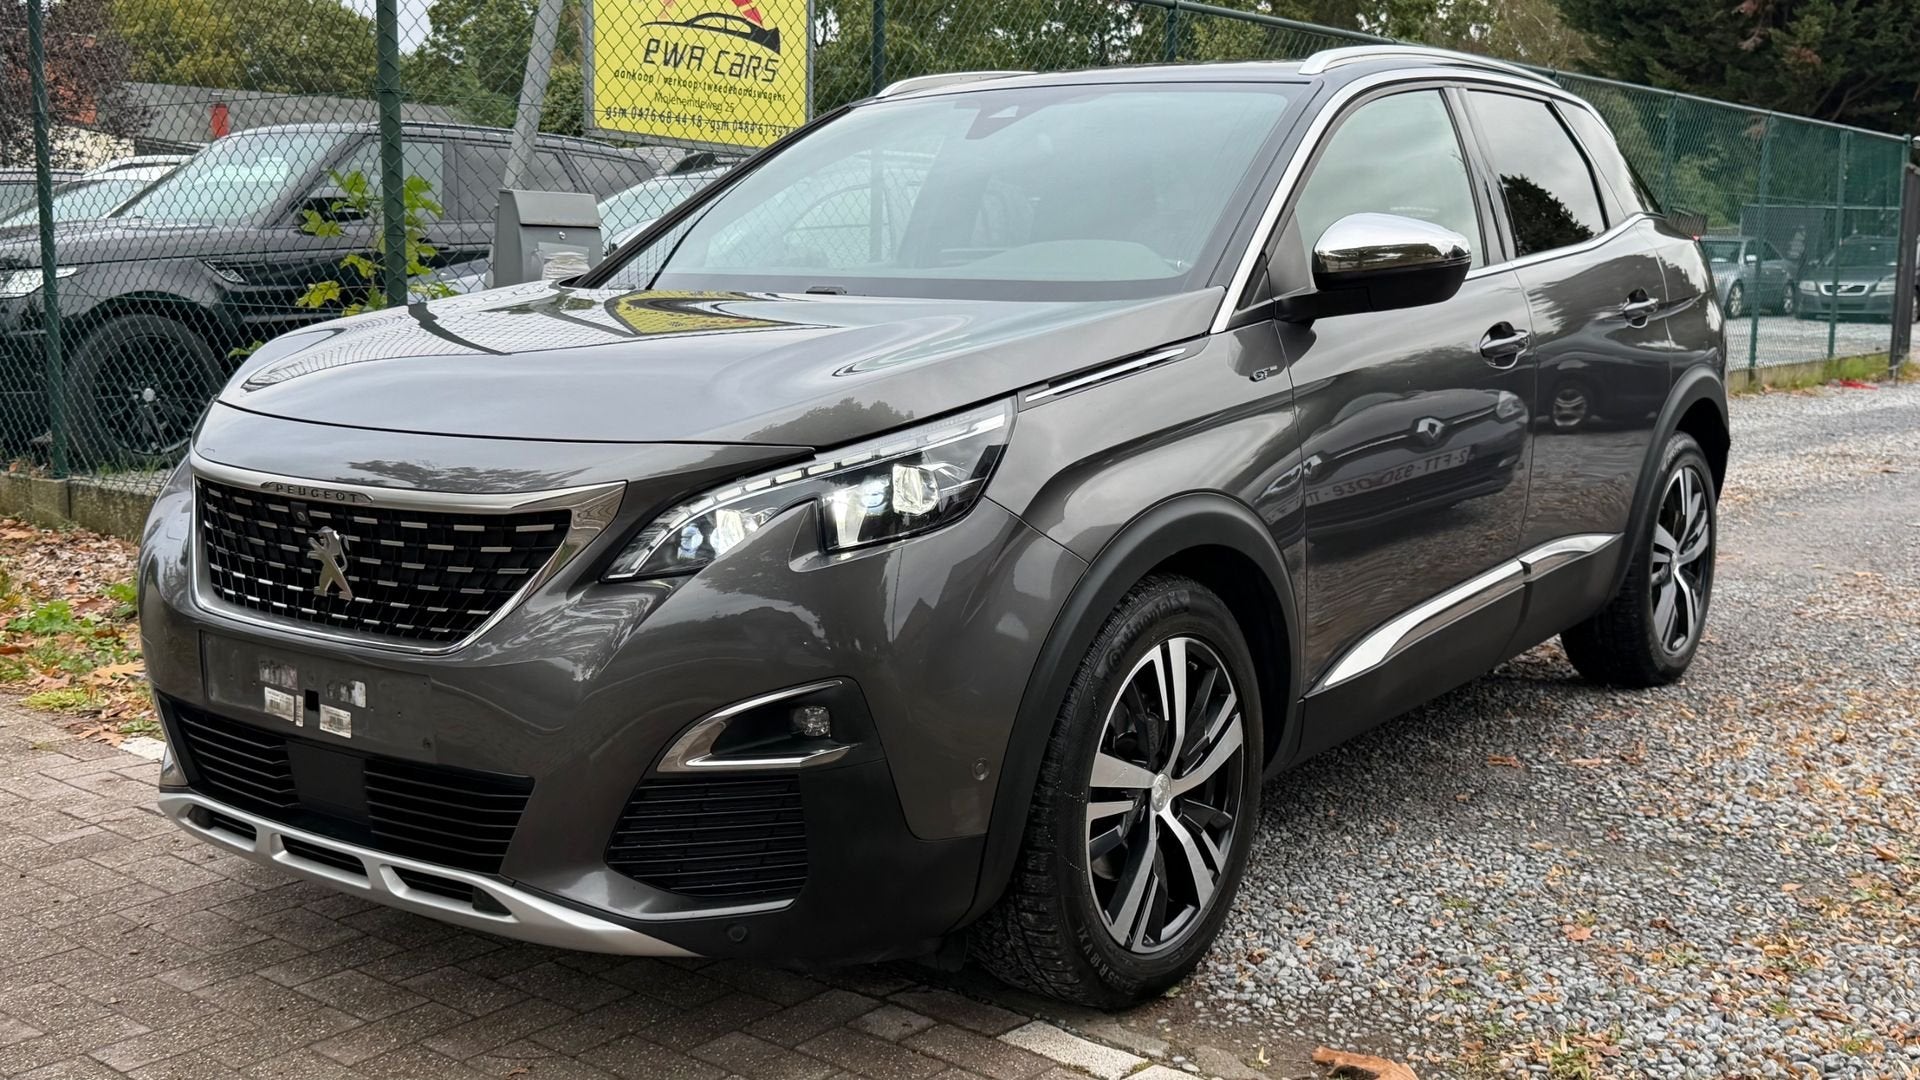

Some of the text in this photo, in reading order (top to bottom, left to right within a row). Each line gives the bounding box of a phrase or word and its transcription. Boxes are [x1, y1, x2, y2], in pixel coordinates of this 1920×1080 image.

[614, 69, 654, 85] aankoop
[664, 76, 698, 92] verkoop
[605, 106, 627, 120] gsm
[631, 107, 656, 122] 0476
[659, 110, 672, 125] 68
[710, 119, 729, 133] gsm
[276, 483, 358, 503] PEUGEOT
